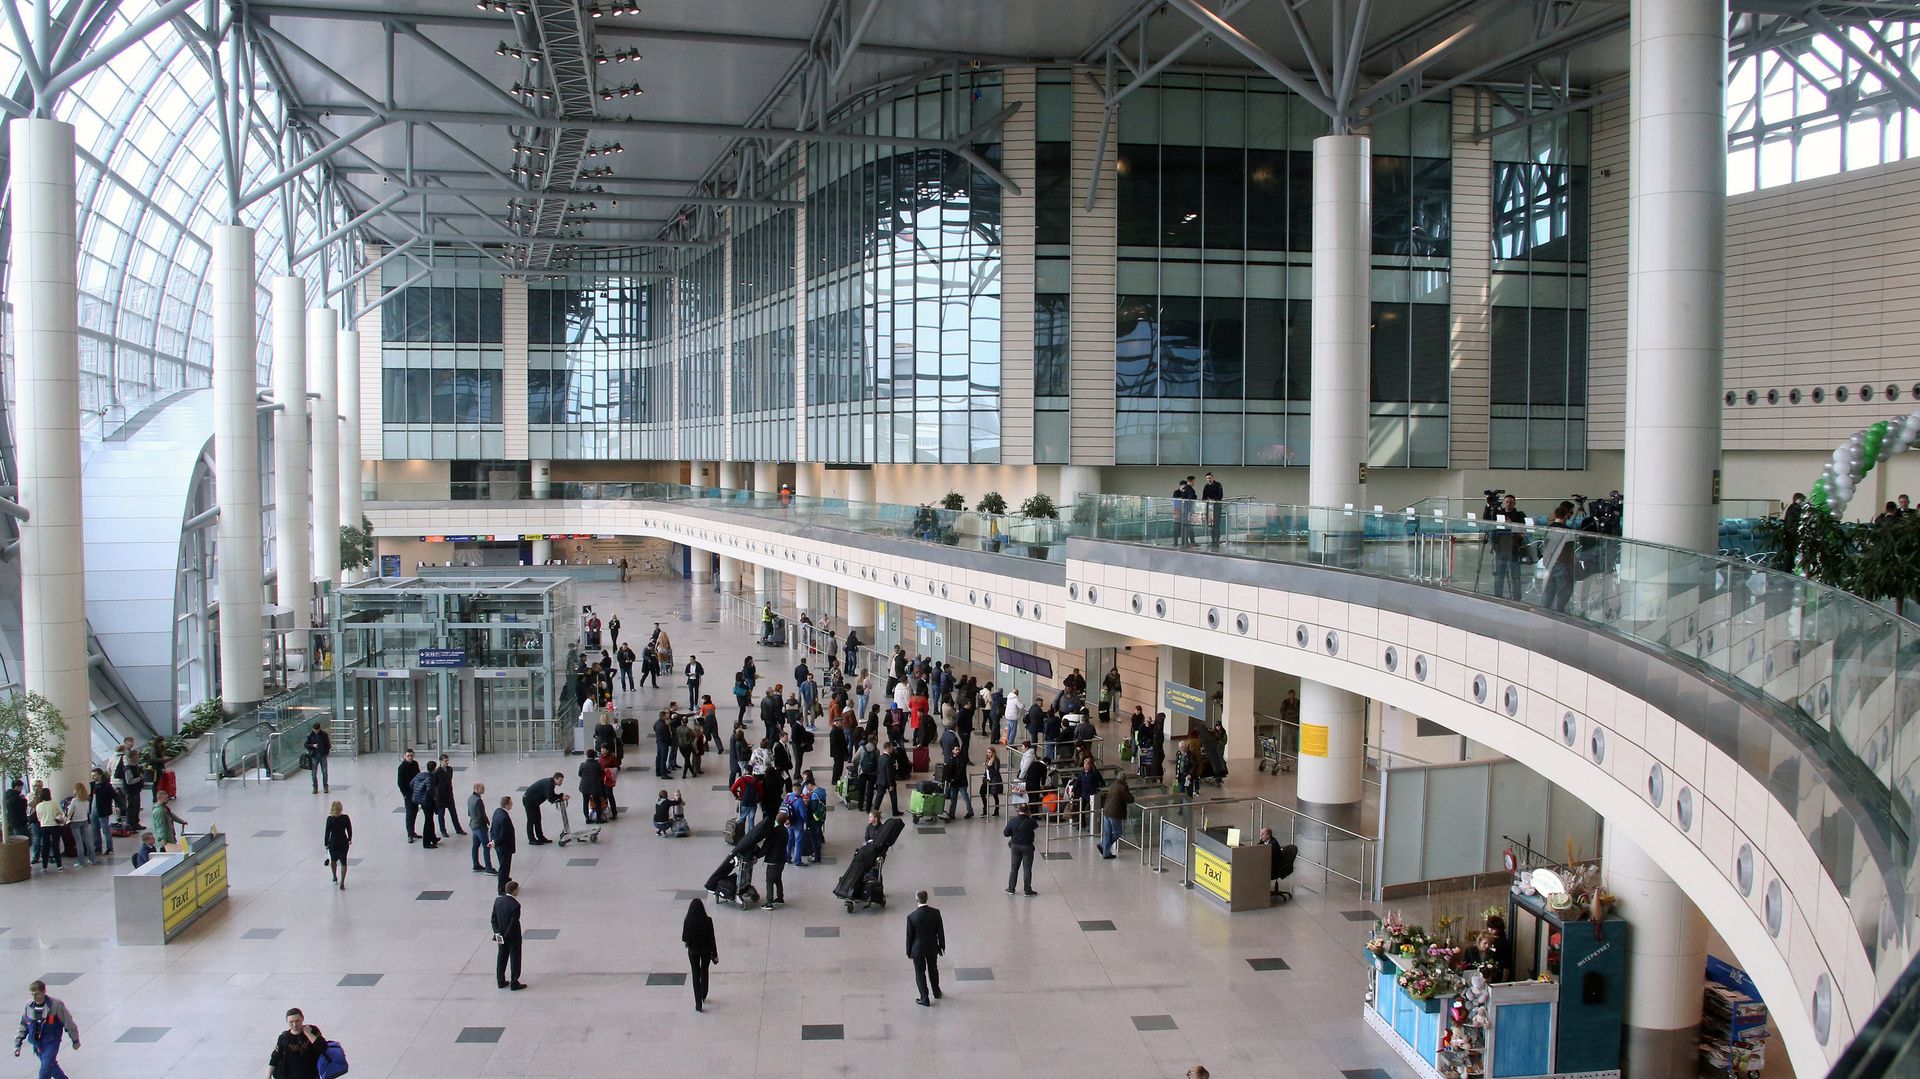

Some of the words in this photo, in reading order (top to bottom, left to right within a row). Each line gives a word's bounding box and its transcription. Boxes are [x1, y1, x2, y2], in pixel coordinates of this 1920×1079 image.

[204, 865, 221, 886] Taxi
[1204, 863, 1222, 883] Taxi
[171, 887, 189, 911] Taxi
